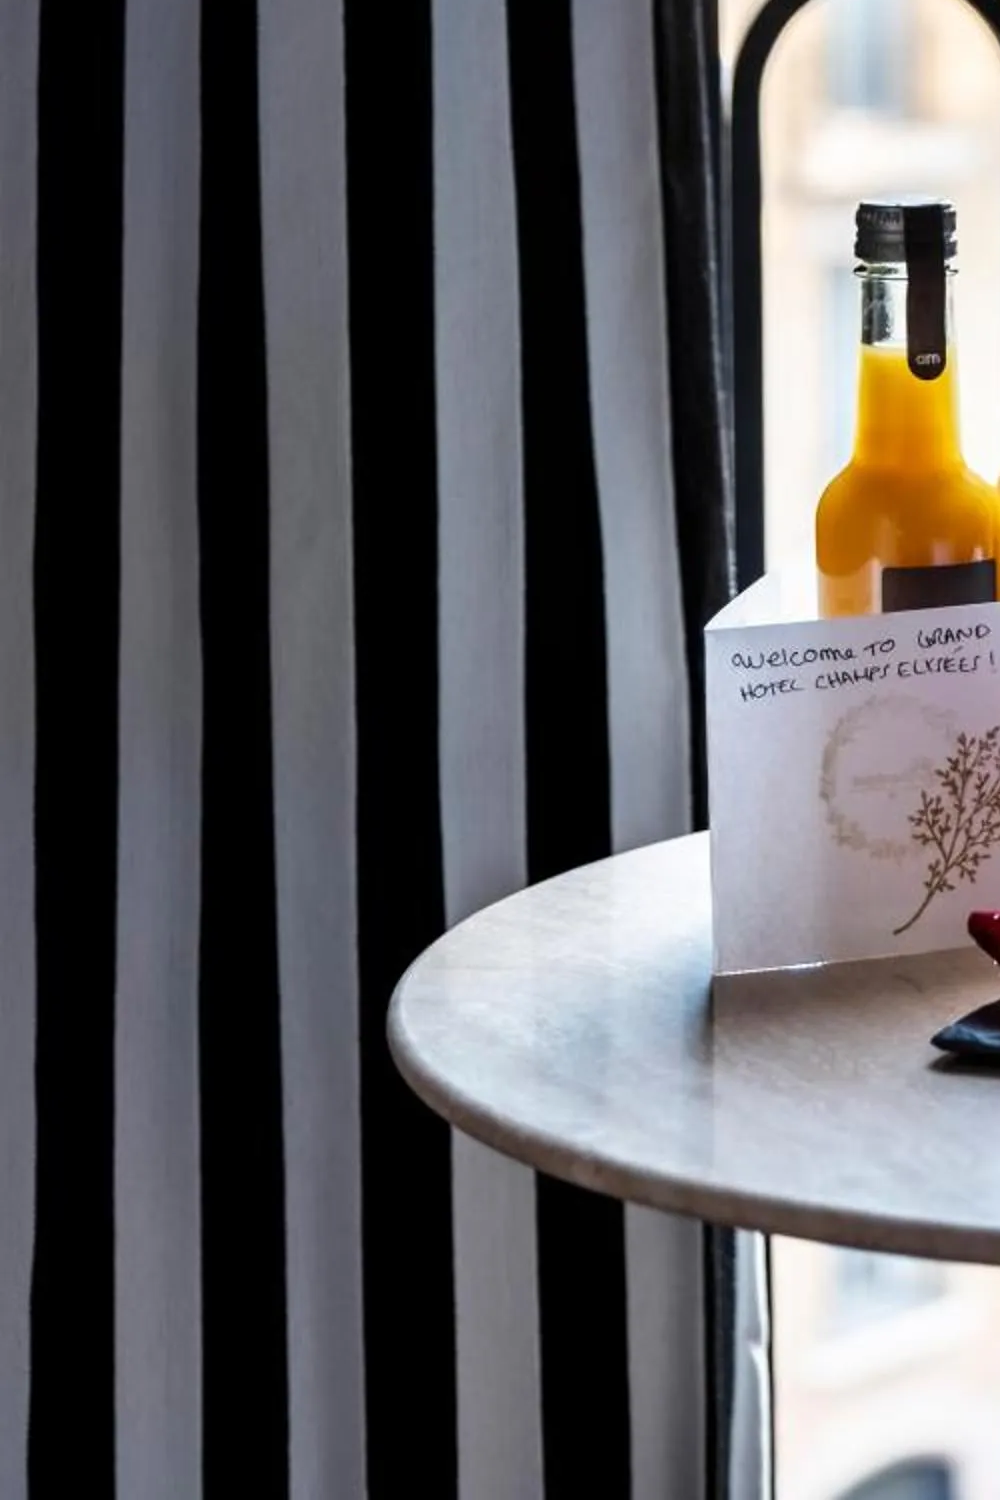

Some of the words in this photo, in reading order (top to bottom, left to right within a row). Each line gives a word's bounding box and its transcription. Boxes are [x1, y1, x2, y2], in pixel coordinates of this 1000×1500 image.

[916, 353, 941, 365] am
[731, 648, 858, 670] Welcome
[862, 638, 897, 658] TO
[917, 623, 993, 649] GRAND
[739, 678, 805, 703] HOTEL
[814, 664, 891, 690] CHAMPS
